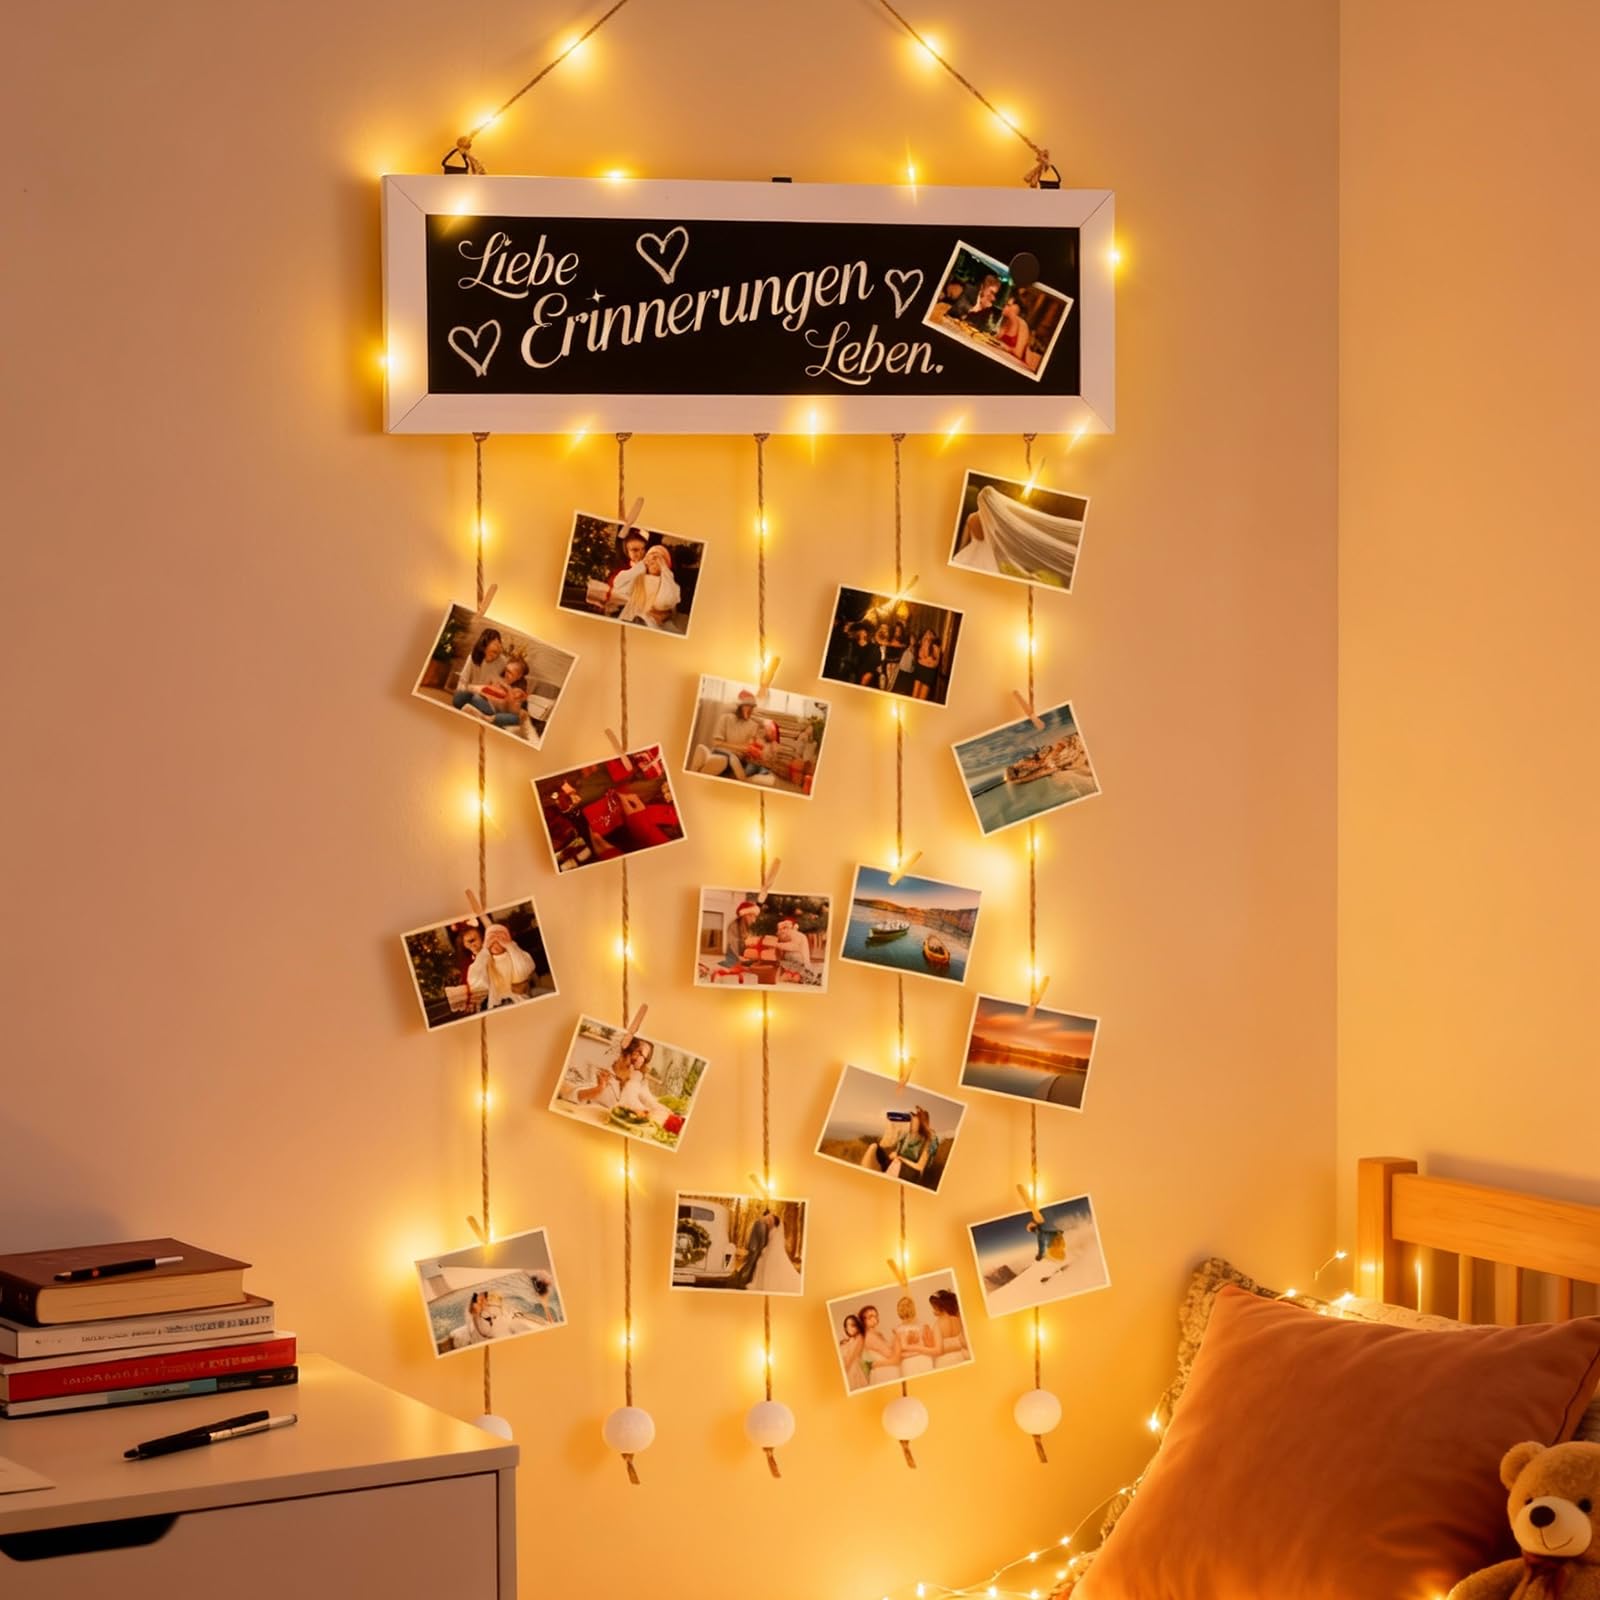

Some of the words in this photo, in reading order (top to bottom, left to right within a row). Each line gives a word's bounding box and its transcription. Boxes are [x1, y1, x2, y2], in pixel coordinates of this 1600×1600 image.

[457, 231, 580, 300] Liebe
[520, 260, 875, 369] Erinnerungen
[804, 320, 944, 386] Leben.
